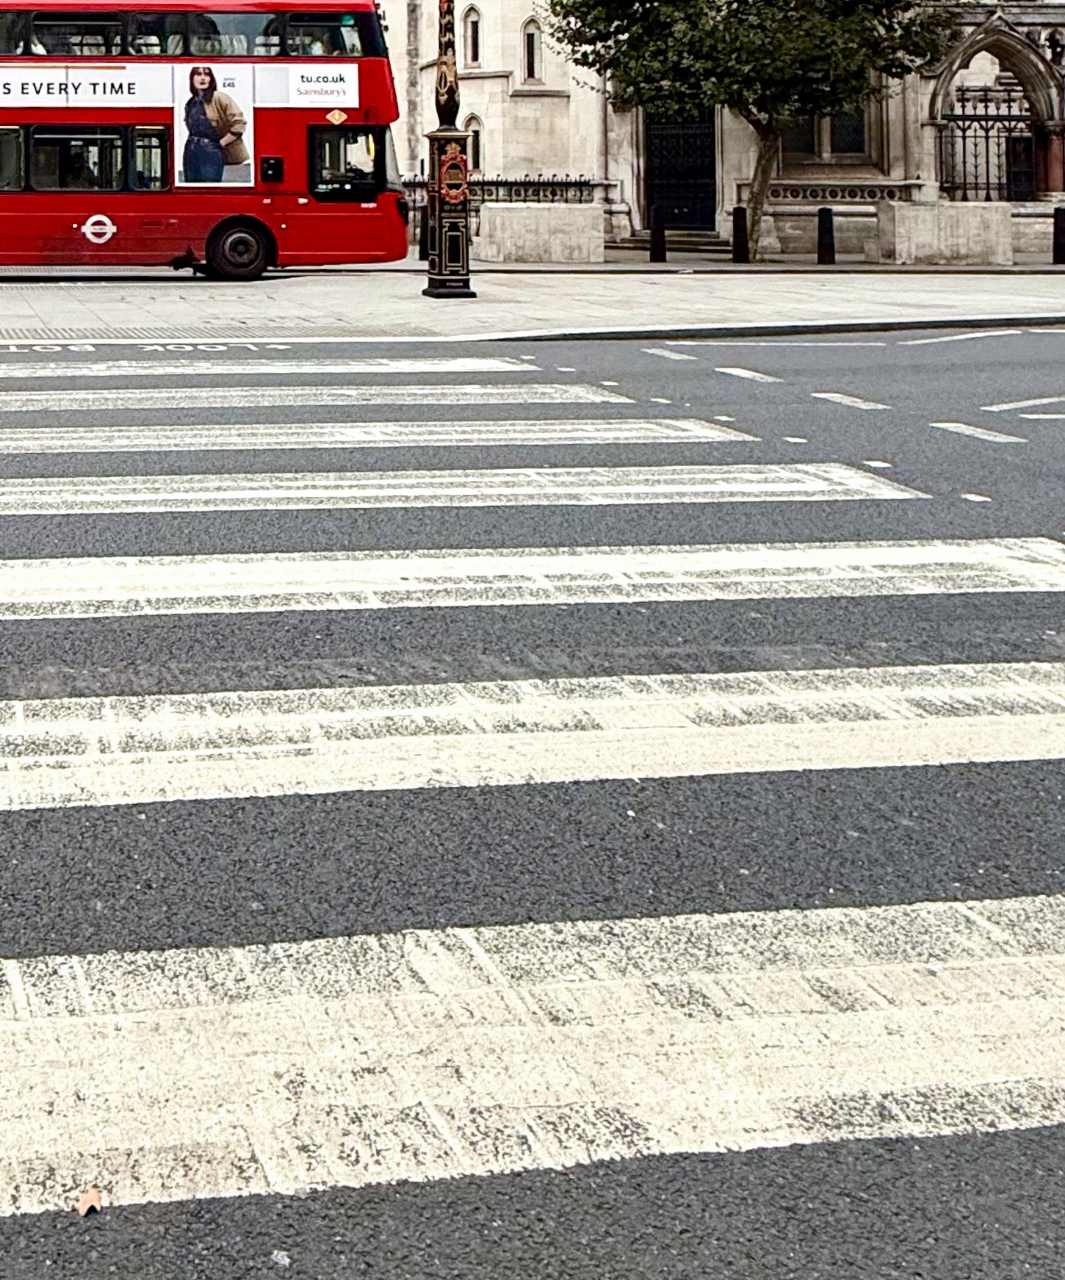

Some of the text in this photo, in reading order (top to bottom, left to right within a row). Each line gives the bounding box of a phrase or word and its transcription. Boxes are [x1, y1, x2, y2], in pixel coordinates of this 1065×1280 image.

[300, 74, 346, 84] tu.co.uk
[20, 82, 82, 95] EVERY
[89, 82, 137, 95] TIME
[296, 87, 347, 97] Sainsbury's
[138, 343, 260, 352] LOOK
